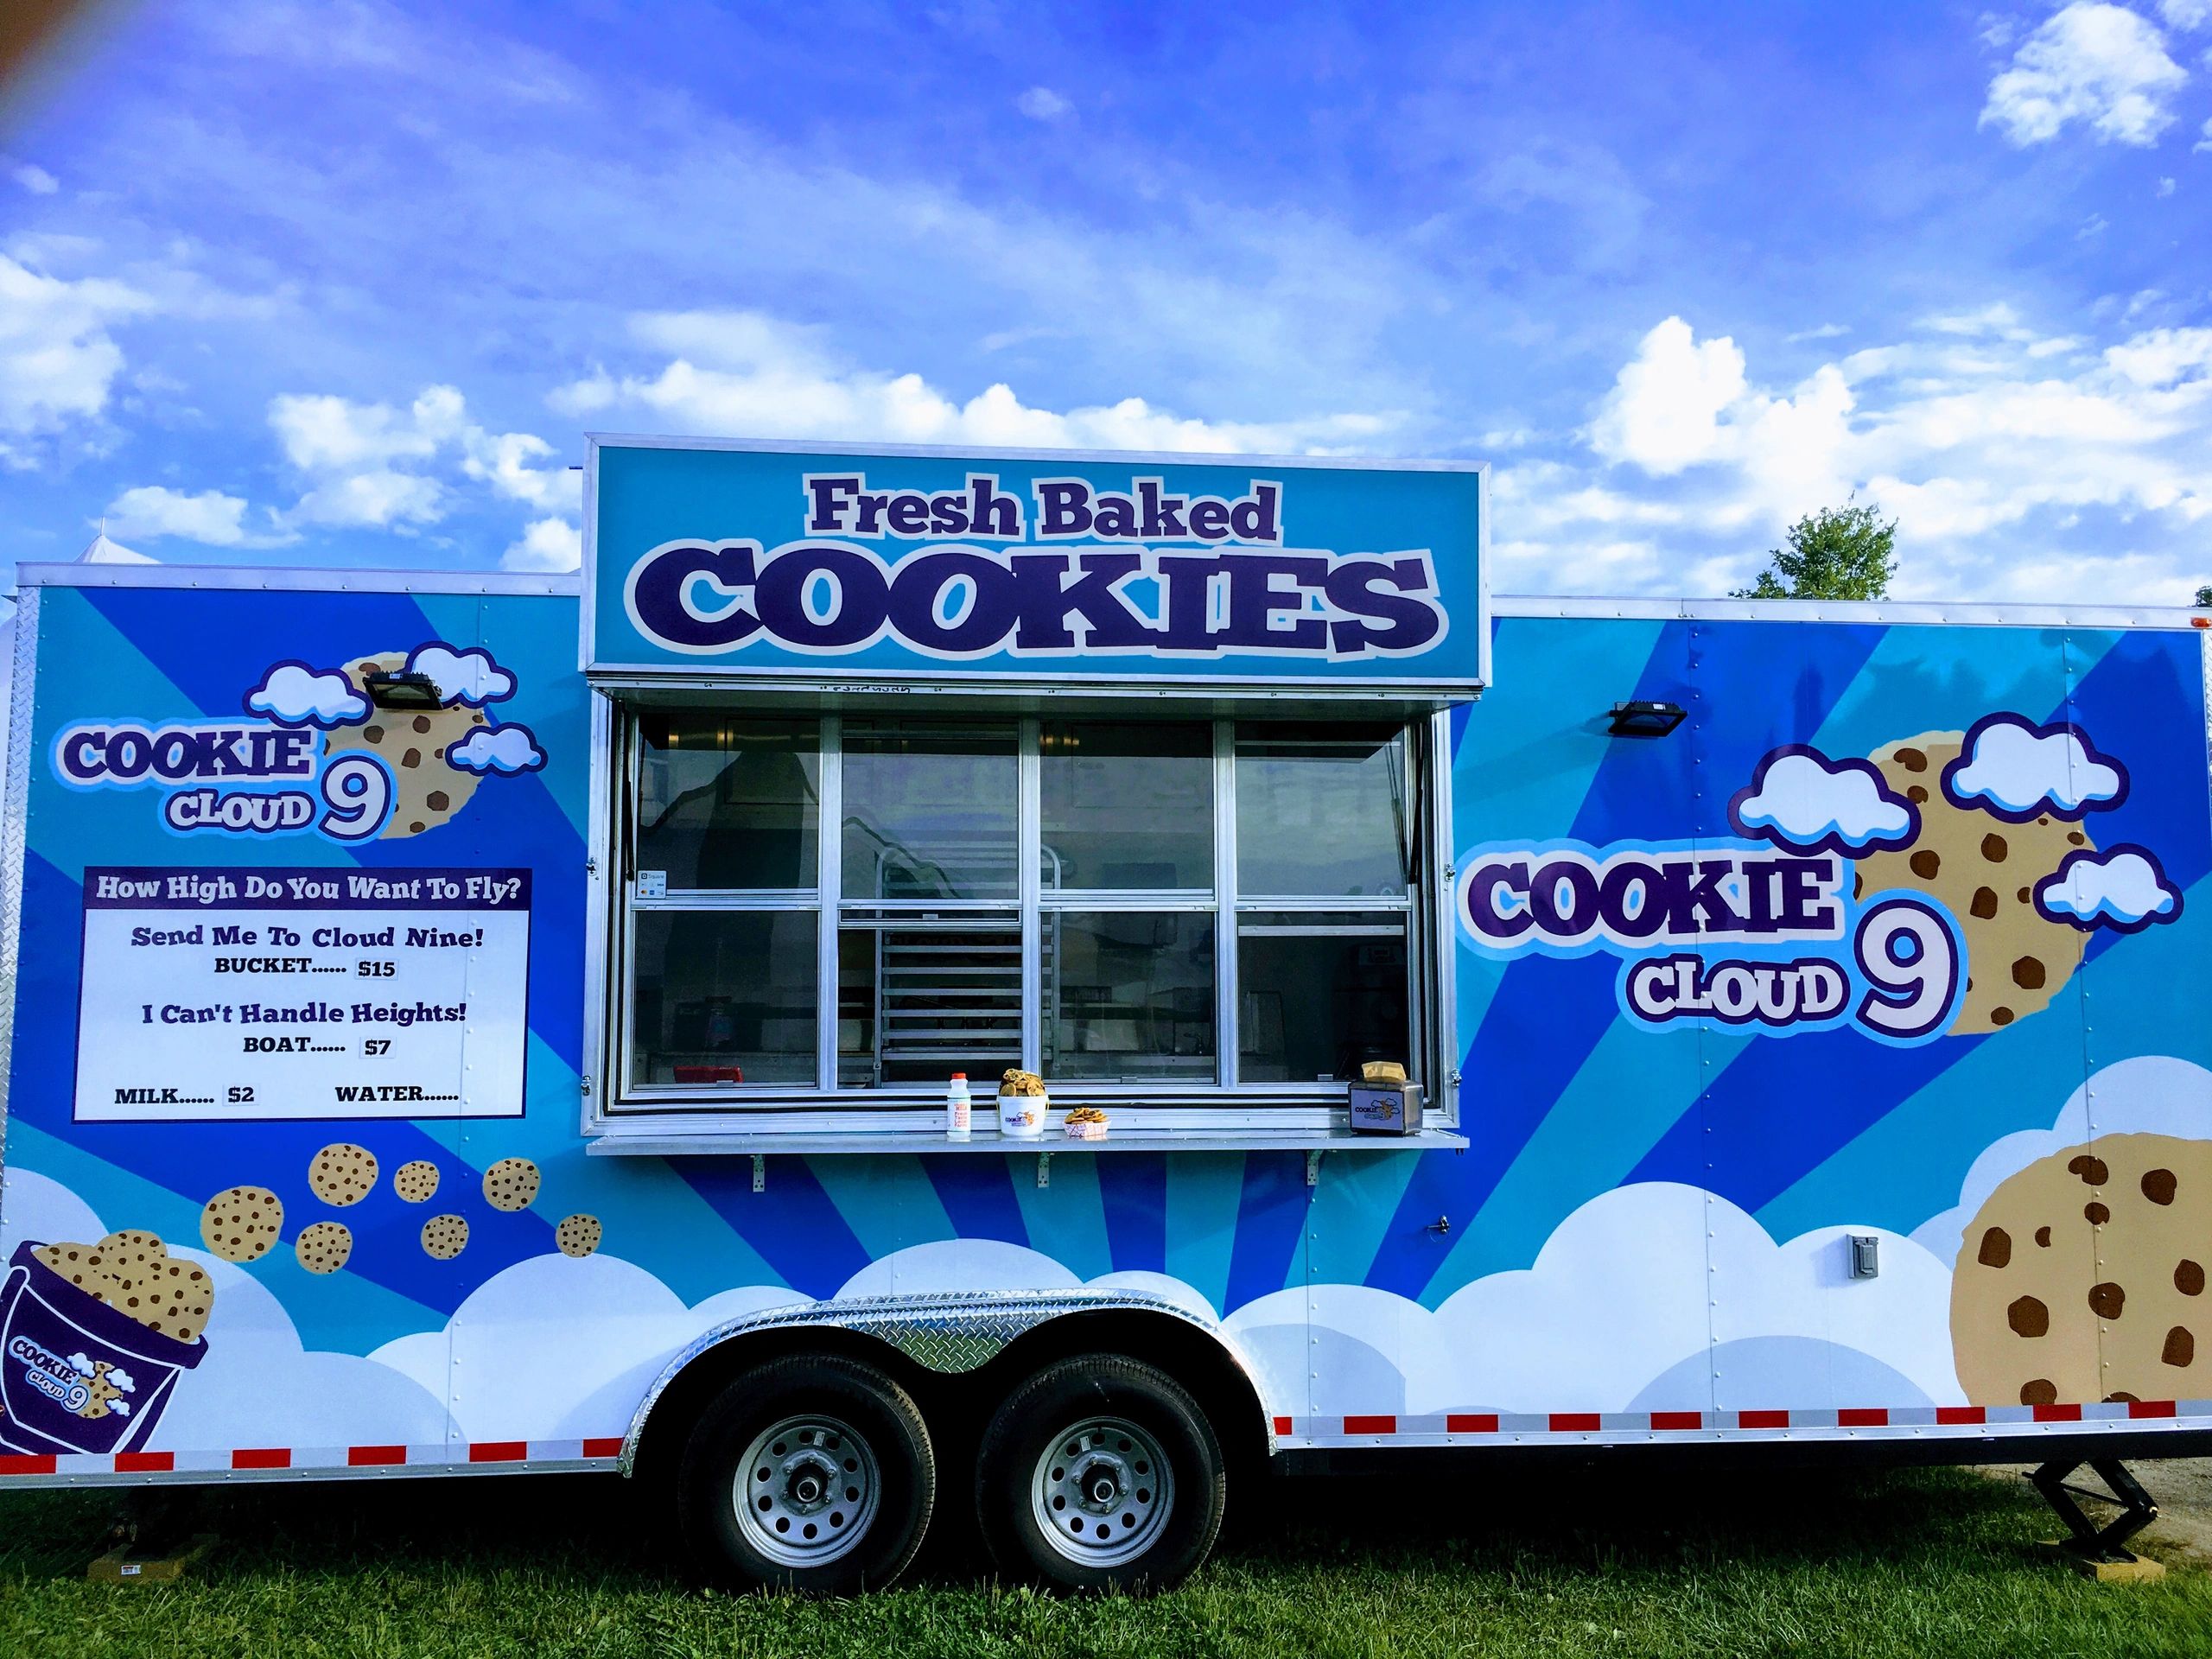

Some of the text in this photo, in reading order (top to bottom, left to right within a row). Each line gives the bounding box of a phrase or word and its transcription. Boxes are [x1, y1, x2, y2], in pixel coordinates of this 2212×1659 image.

[809, 478, 1277, 542] Fresh Baked
[634, 547, 1440, 651] COOKIES
[63, 730, 311, 778] COOKIE
[170, 759, 385, 836] CLOUD 9
[96, 875, 521, 905] How High Do You Want To Fly?
[1468, 858, 1837, 938] COOKIE
[130, 925, 484, 948] Send Me To Cloud Nine!
[358, 961, 396, 977] $15
[1634, 907, 1952, 1032] CLOUD 9
[142, 1001, 467, 1027] I Can't Handle Heights!
[365, 1039, 391, 1056] $7
[227, 1086, 255, 1103] $2
[12, 1339, 78, 1385] COOKIE
[28, 1370, 88, 1410] CLOUD 9
